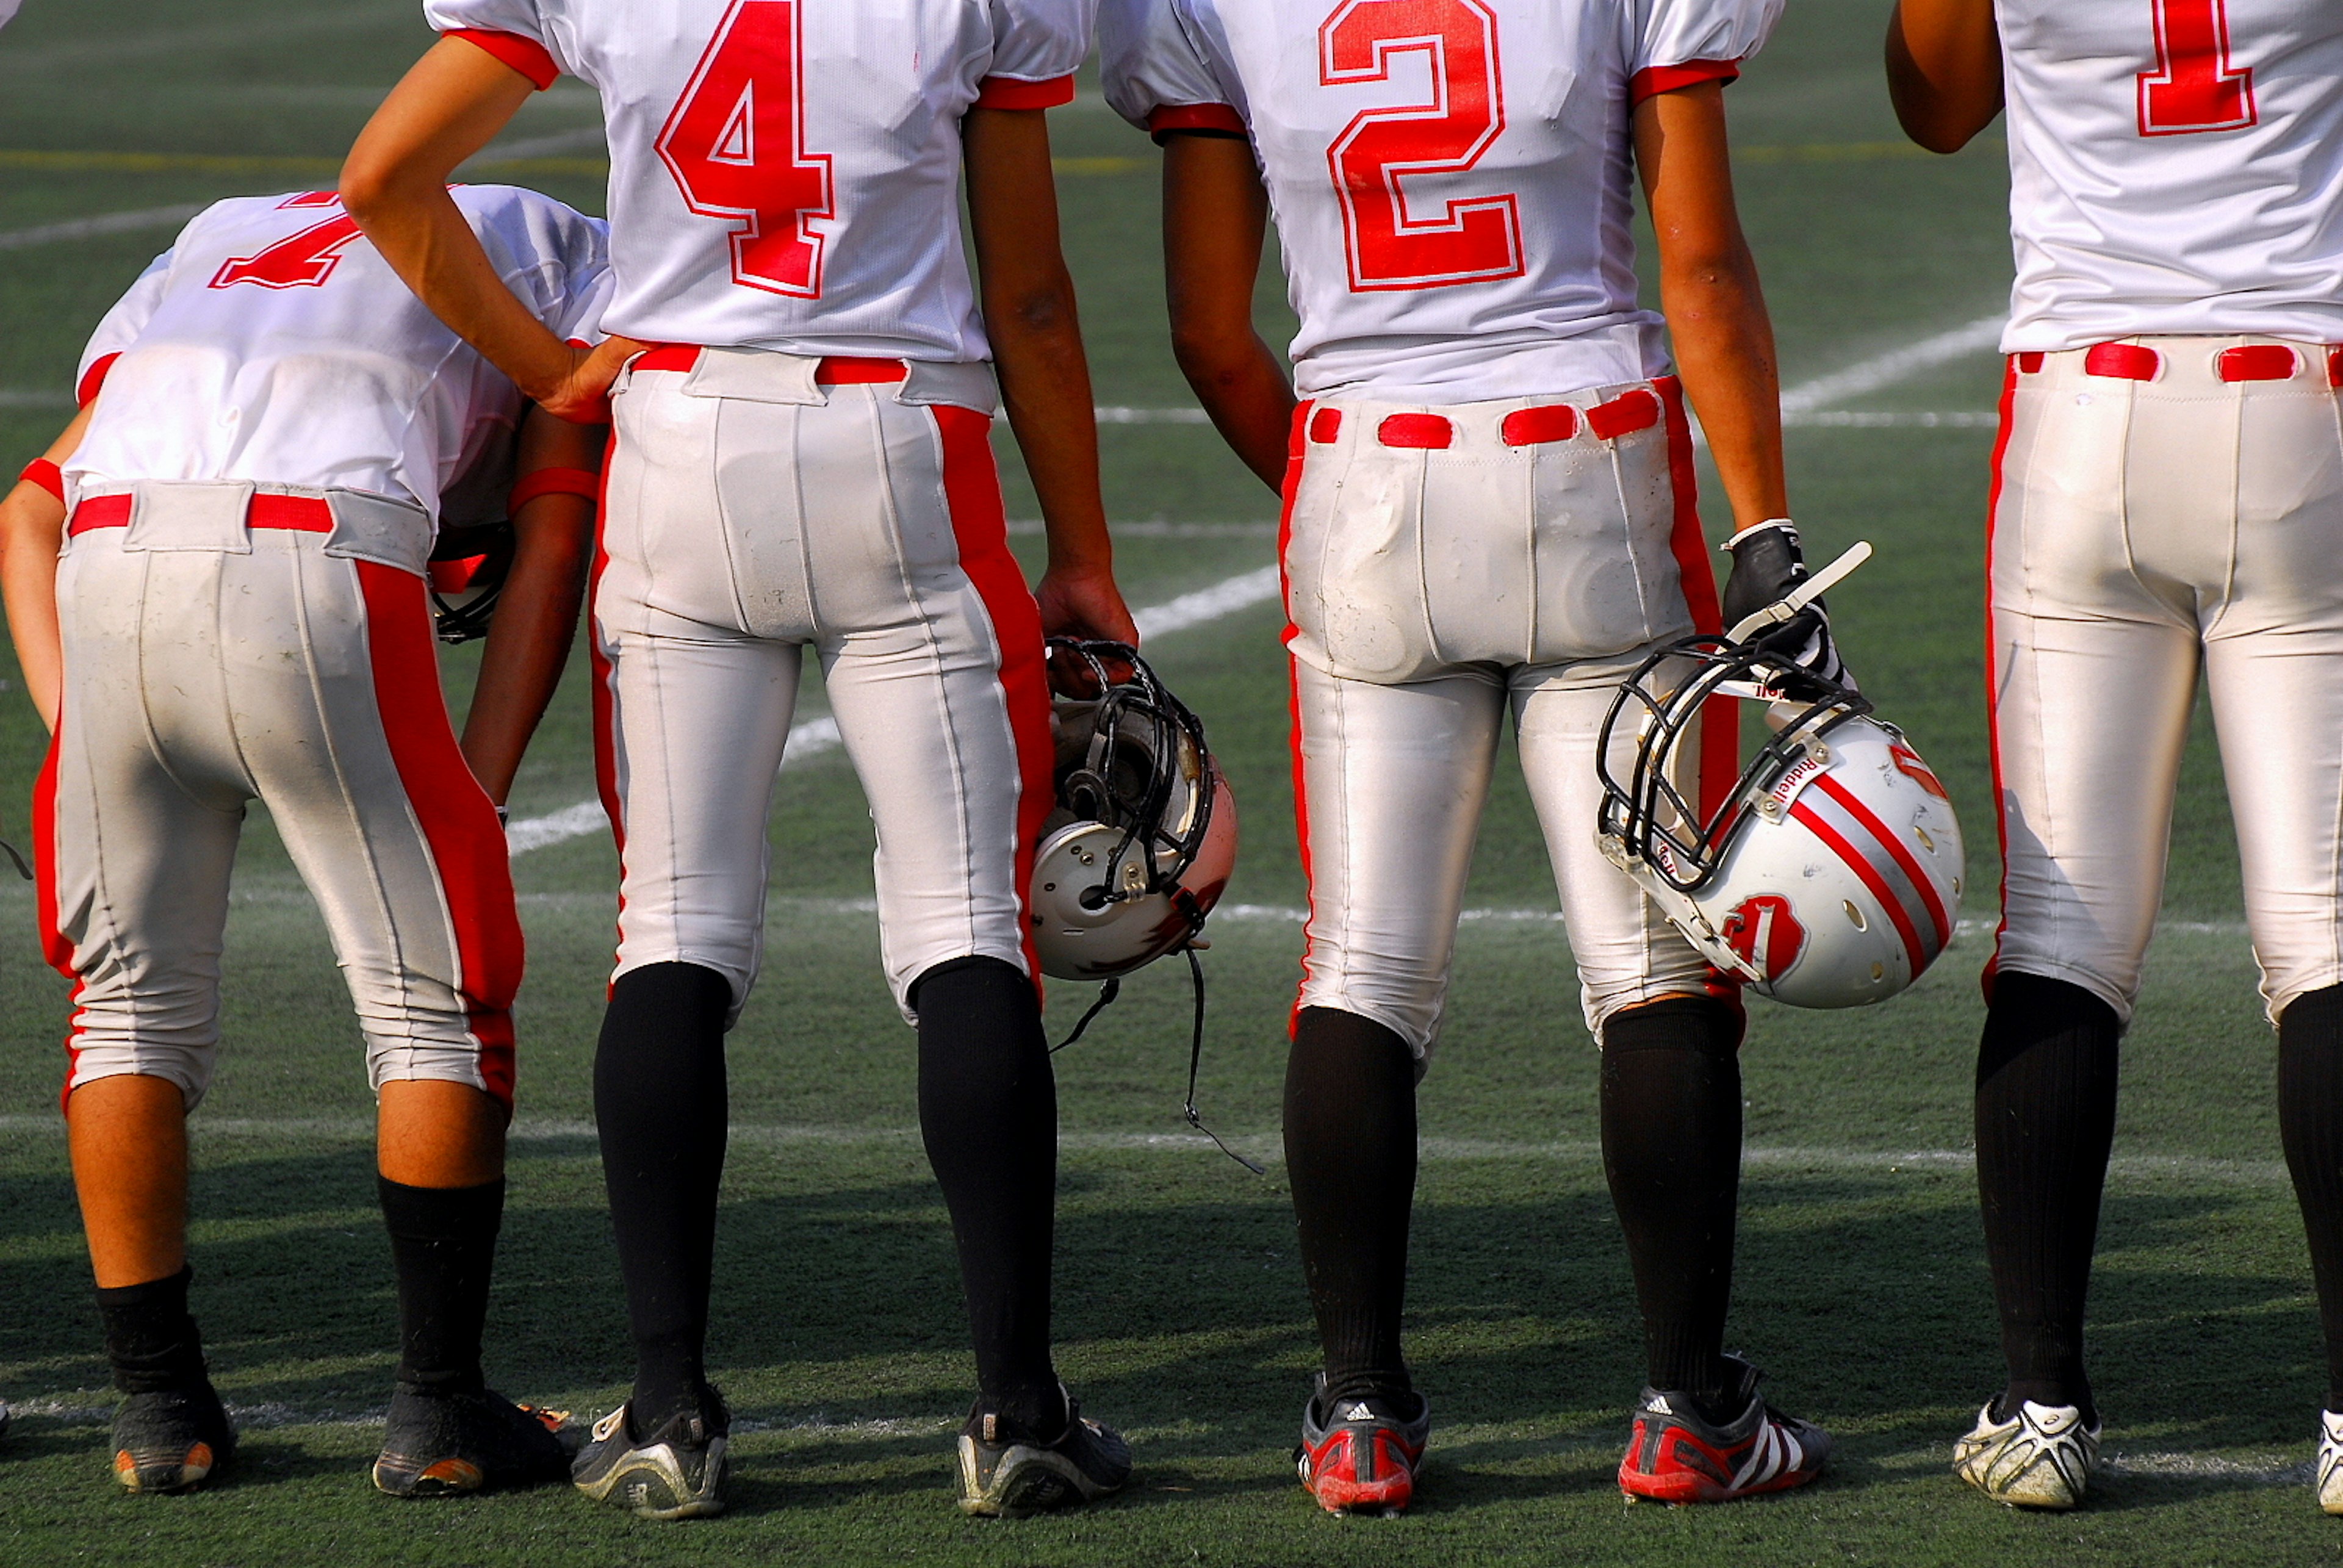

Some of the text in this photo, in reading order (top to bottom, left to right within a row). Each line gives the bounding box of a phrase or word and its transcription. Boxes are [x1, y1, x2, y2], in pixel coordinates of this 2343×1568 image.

[653, 0, 834, 299] 4
[1318, 0, 1525, 293] 2
[1772, 757, 1818, 804] Riddell
